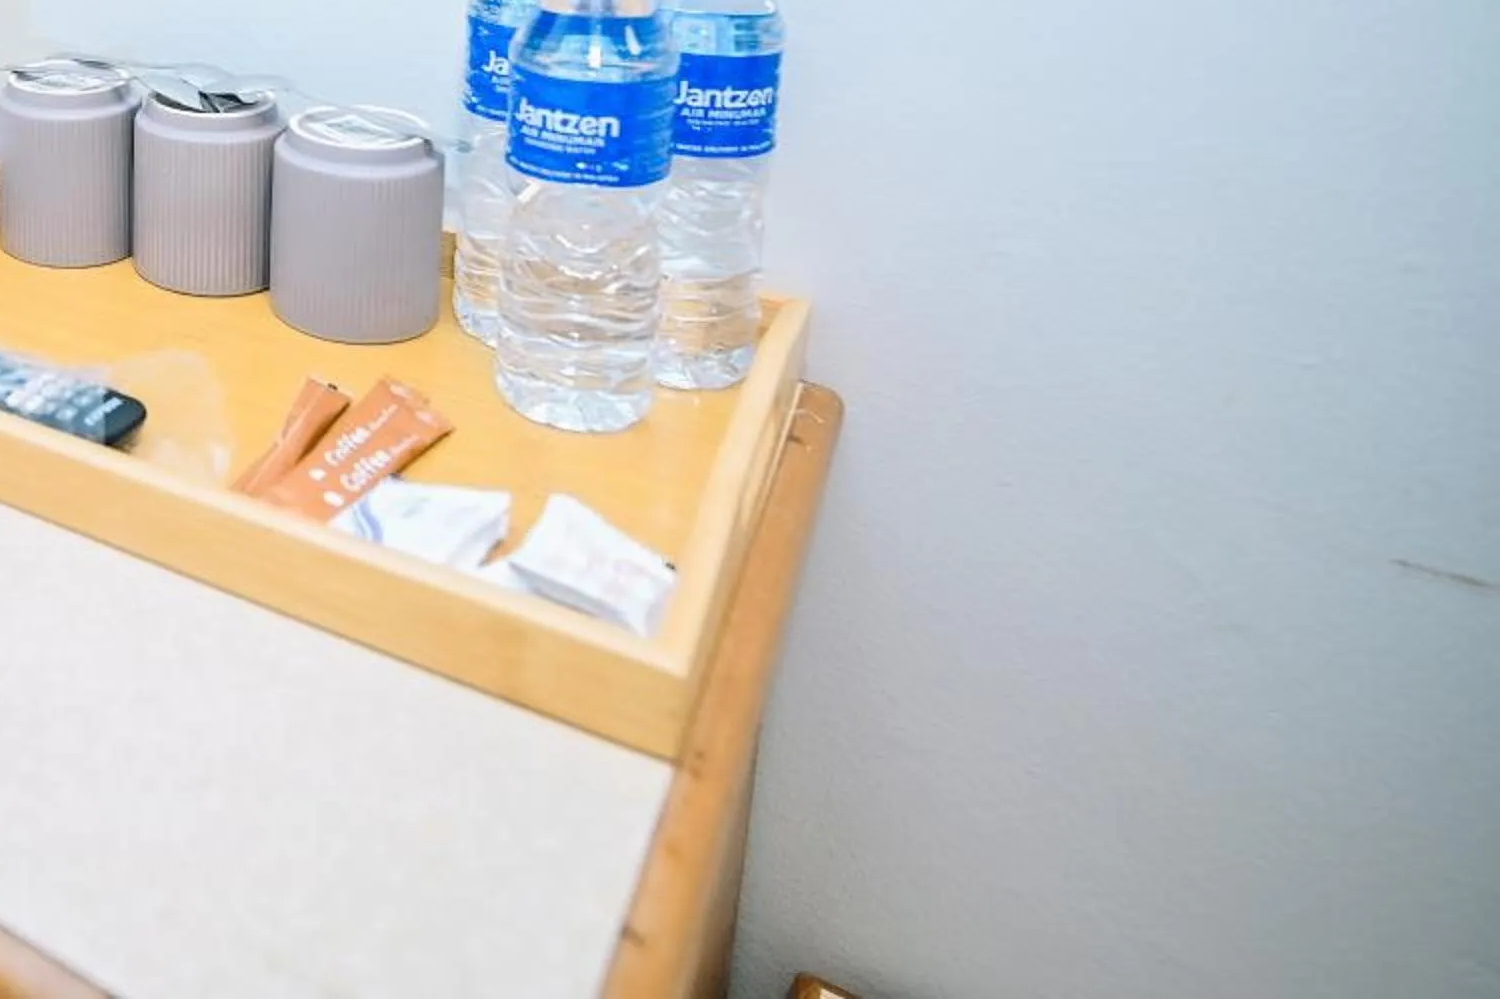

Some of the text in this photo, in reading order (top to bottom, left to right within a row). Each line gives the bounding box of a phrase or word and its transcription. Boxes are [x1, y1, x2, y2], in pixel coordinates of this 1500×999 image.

[673, 80, 772, 107] Jantzen
[515, 97, 620, 137] Jantzen
[324, 427, 370, 467] Coffee
[340, 450, 391, 492] Coffee
